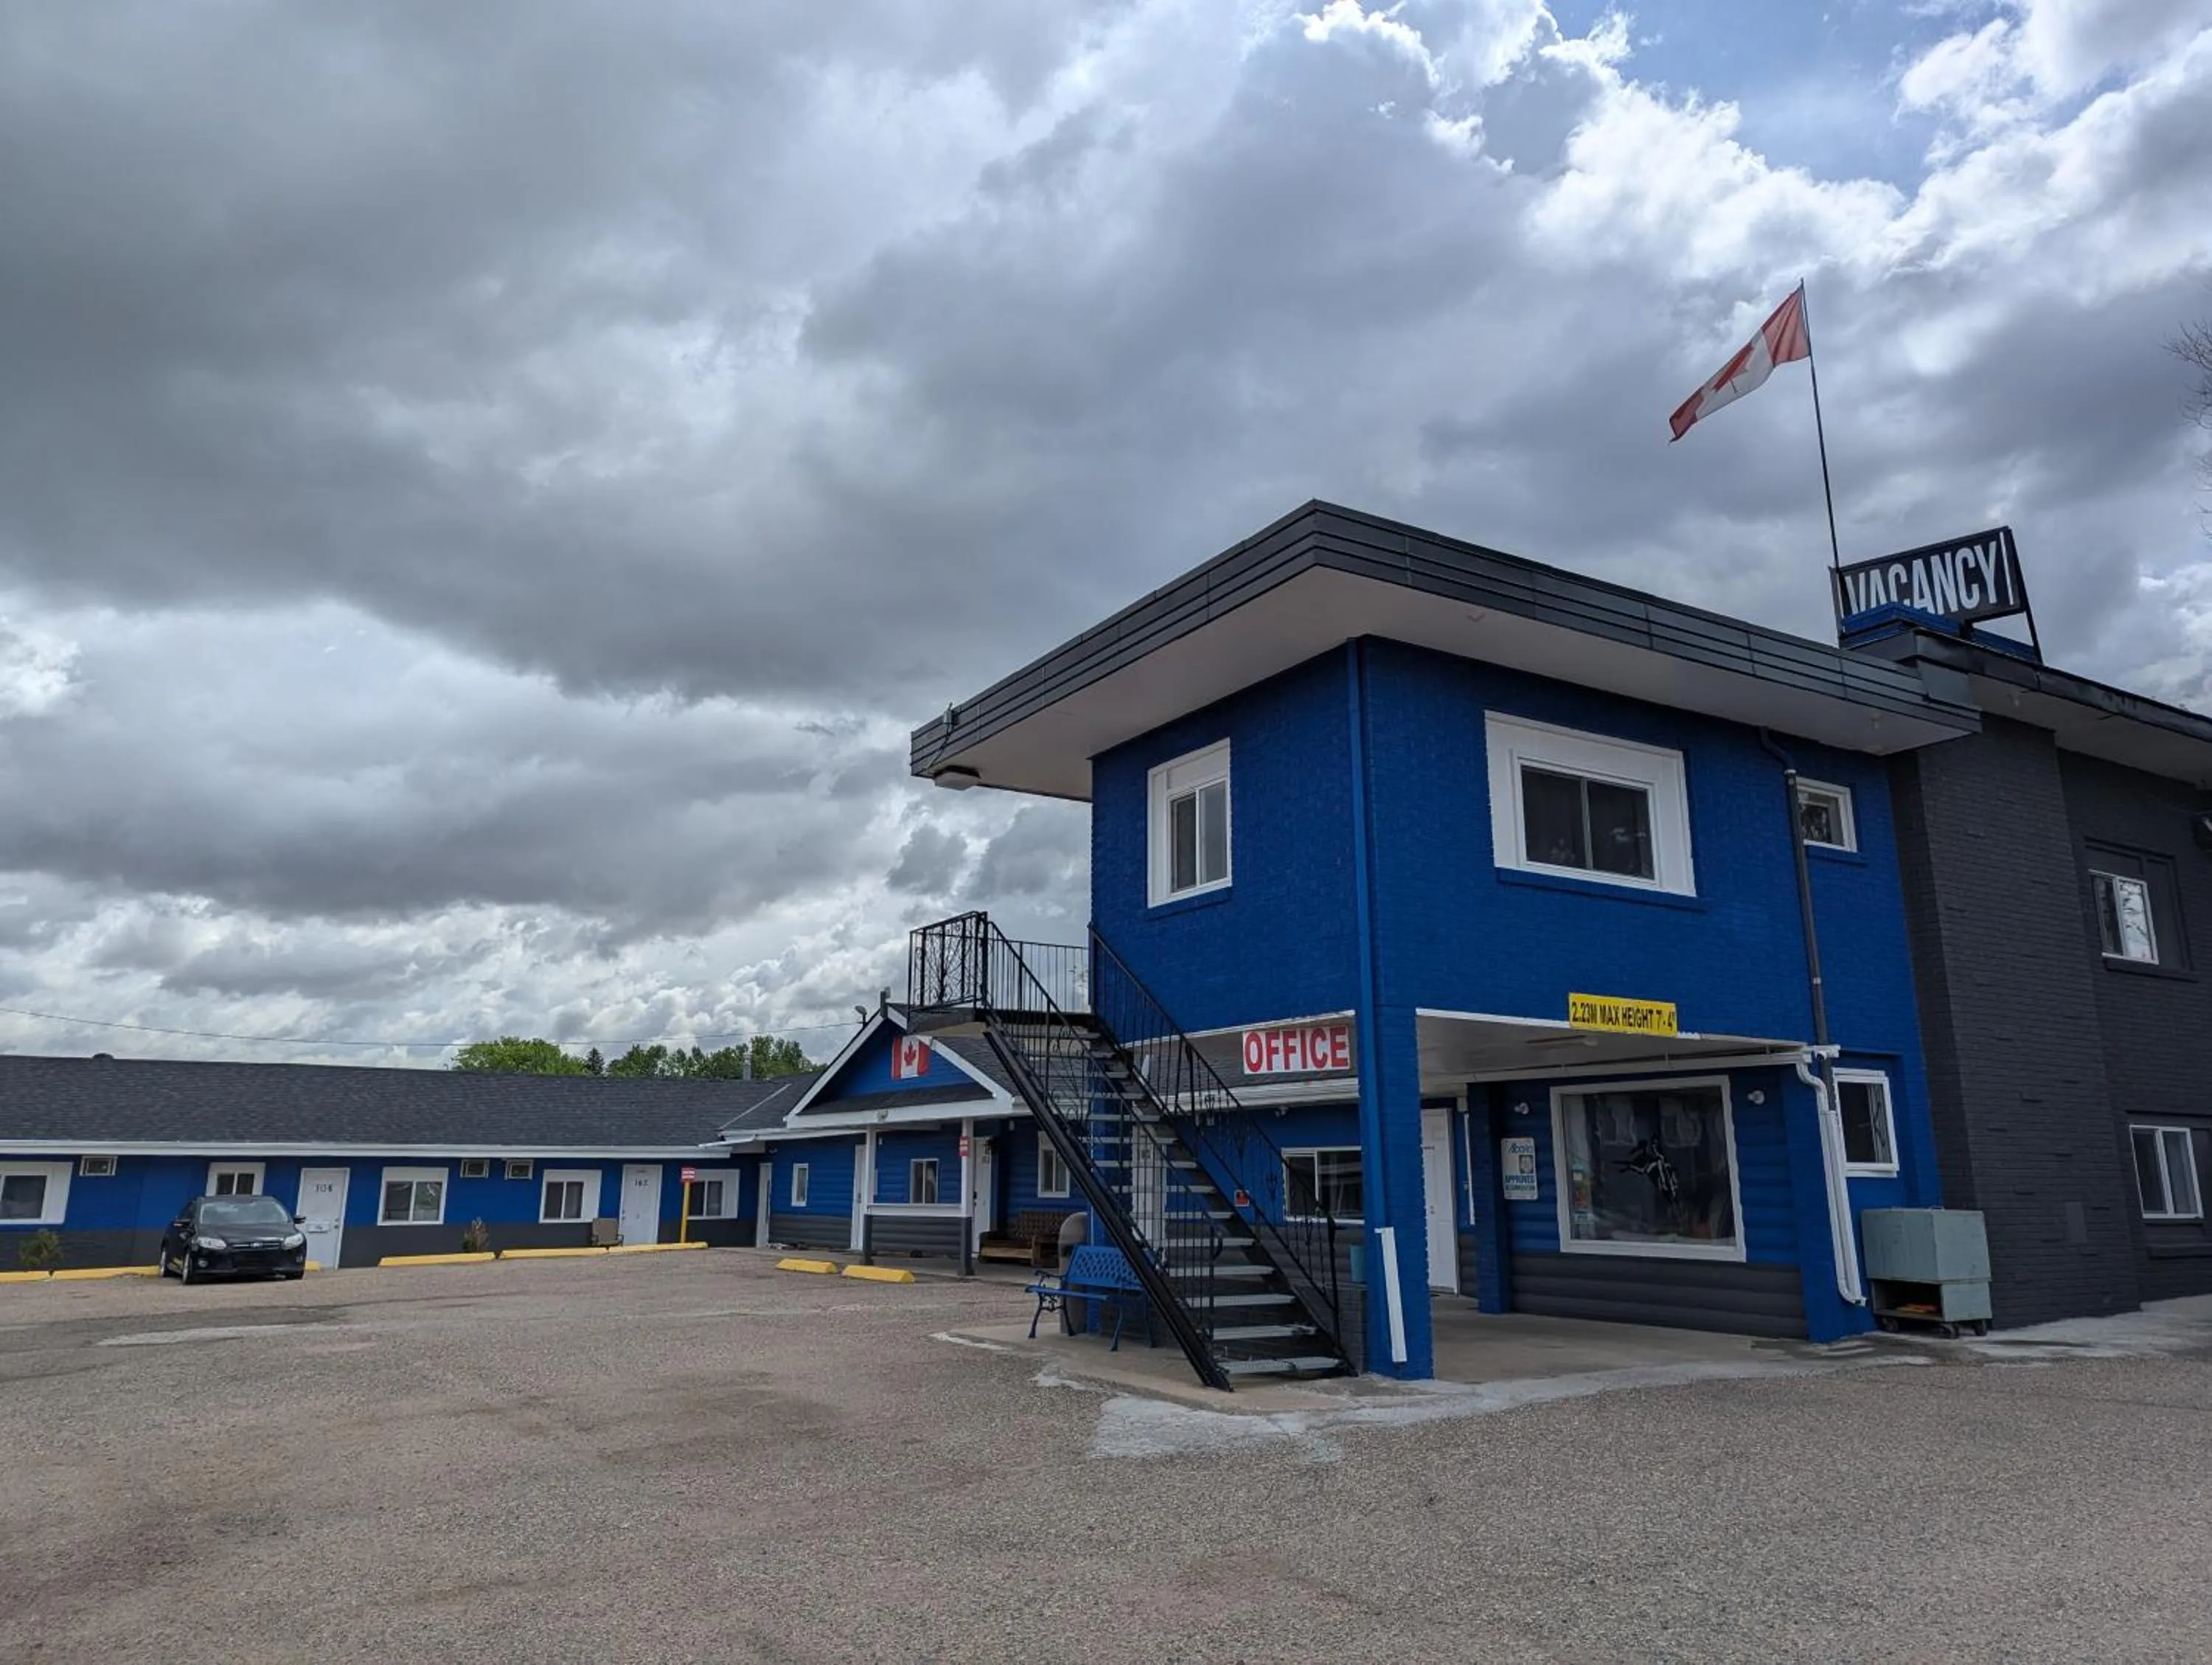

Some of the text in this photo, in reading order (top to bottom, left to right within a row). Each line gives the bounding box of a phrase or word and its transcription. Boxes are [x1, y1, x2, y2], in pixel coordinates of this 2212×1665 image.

[1845, 541, 1997, 615] VACANCY
[1599, 1004, 1620, 1026] MAX
[1621, 1006, 1654, 1029] HEIGHT
[1245, 1026, 1349, 1073] OFFICE
